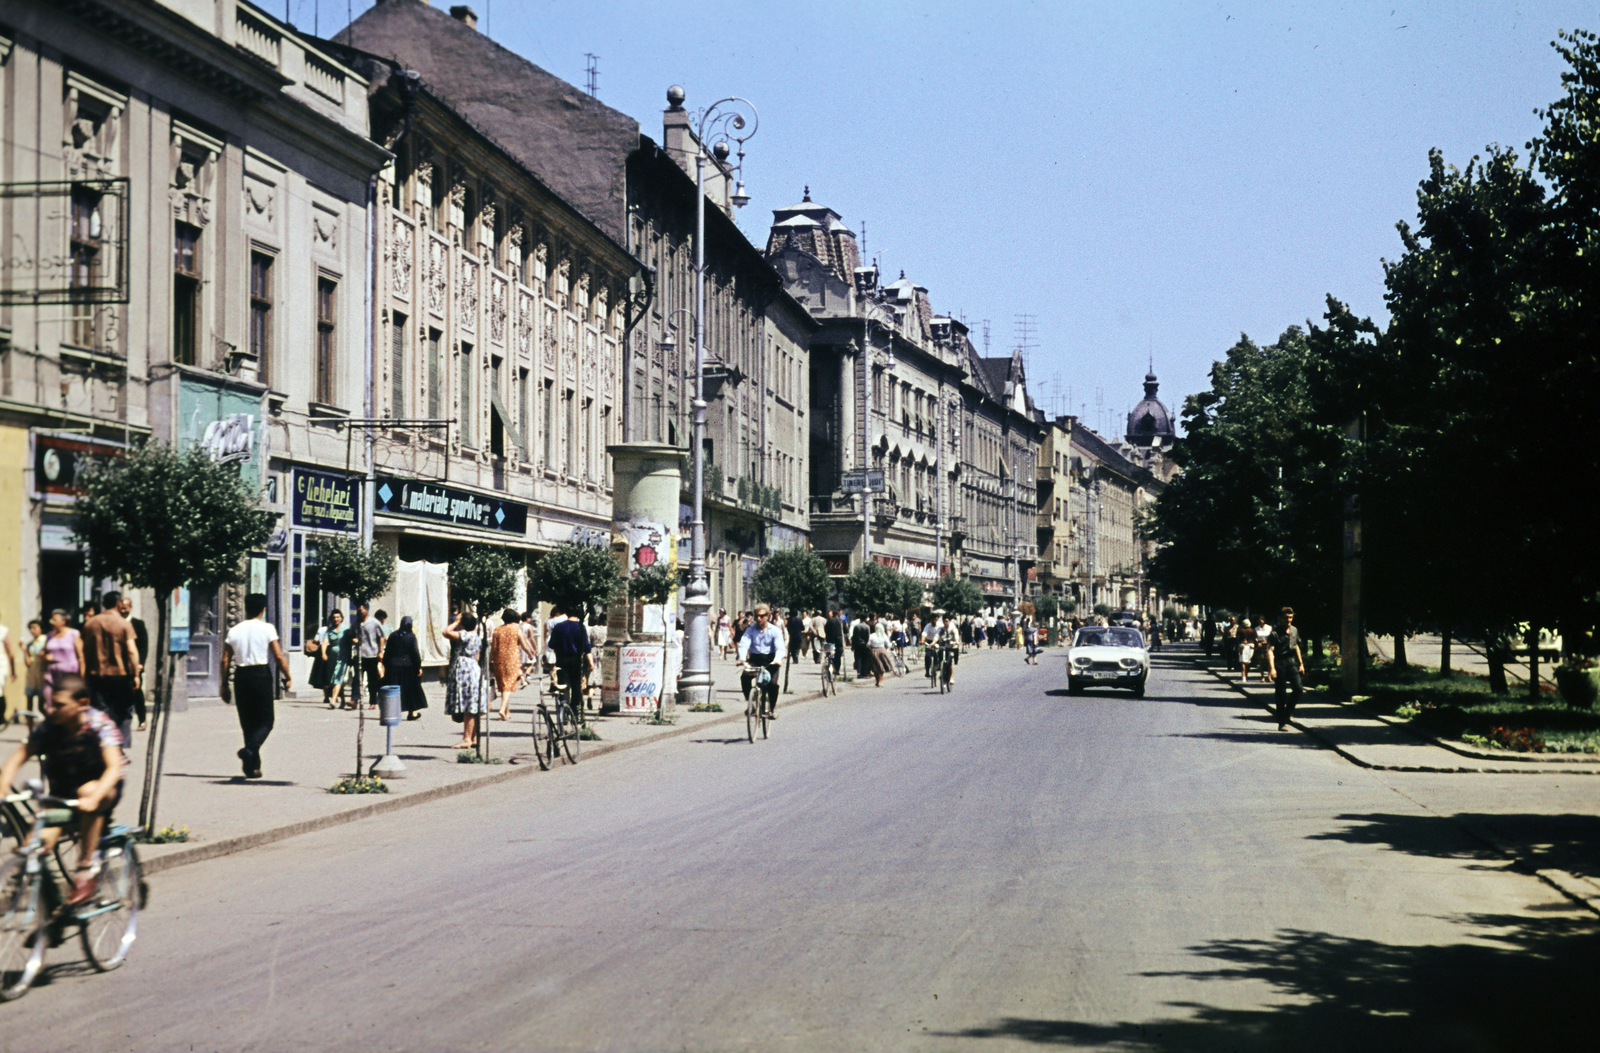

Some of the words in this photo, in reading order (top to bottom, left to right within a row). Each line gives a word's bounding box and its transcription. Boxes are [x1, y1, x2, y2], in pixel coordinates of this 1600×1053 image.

[409, 486, 449, 515] materiale
[450, 495, 483, 523] sportive
[625, 682, 656, 694] RAPID
